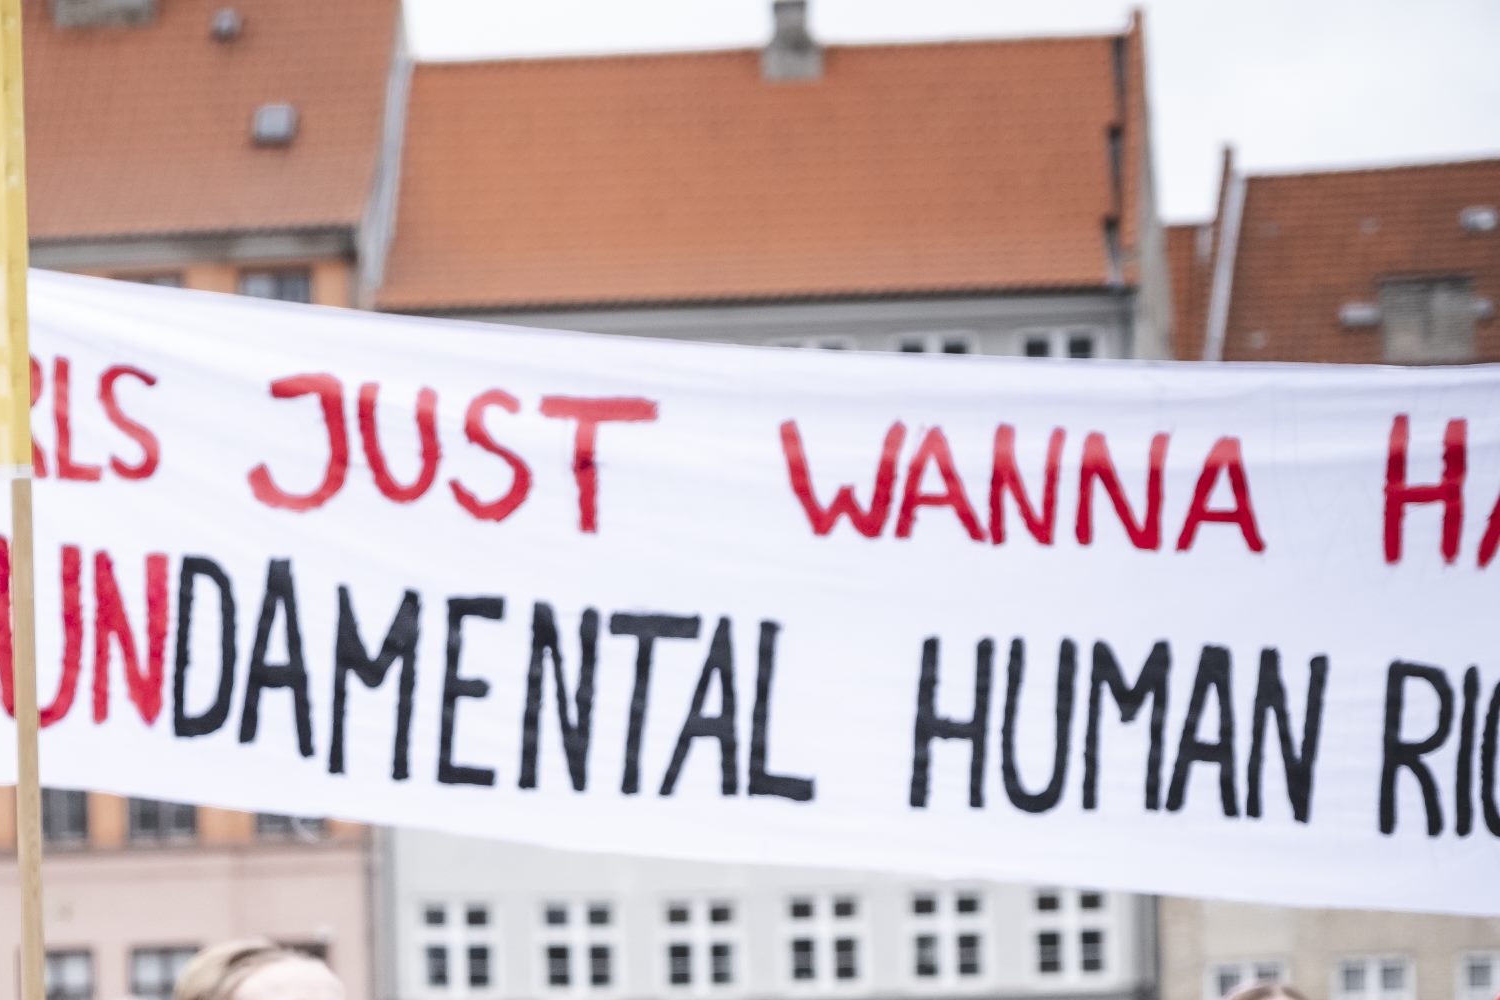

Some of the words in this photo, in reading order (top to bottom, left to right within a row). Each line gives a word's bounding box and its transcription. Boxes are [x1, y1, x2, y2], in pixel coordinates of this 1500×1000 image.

[248, 372, 660, 533] JUST
[779, 417, 1266, 554] WANNA
[1383, 413, 1500, 569] H
[909, 634, 1329, 824] HUMAN
